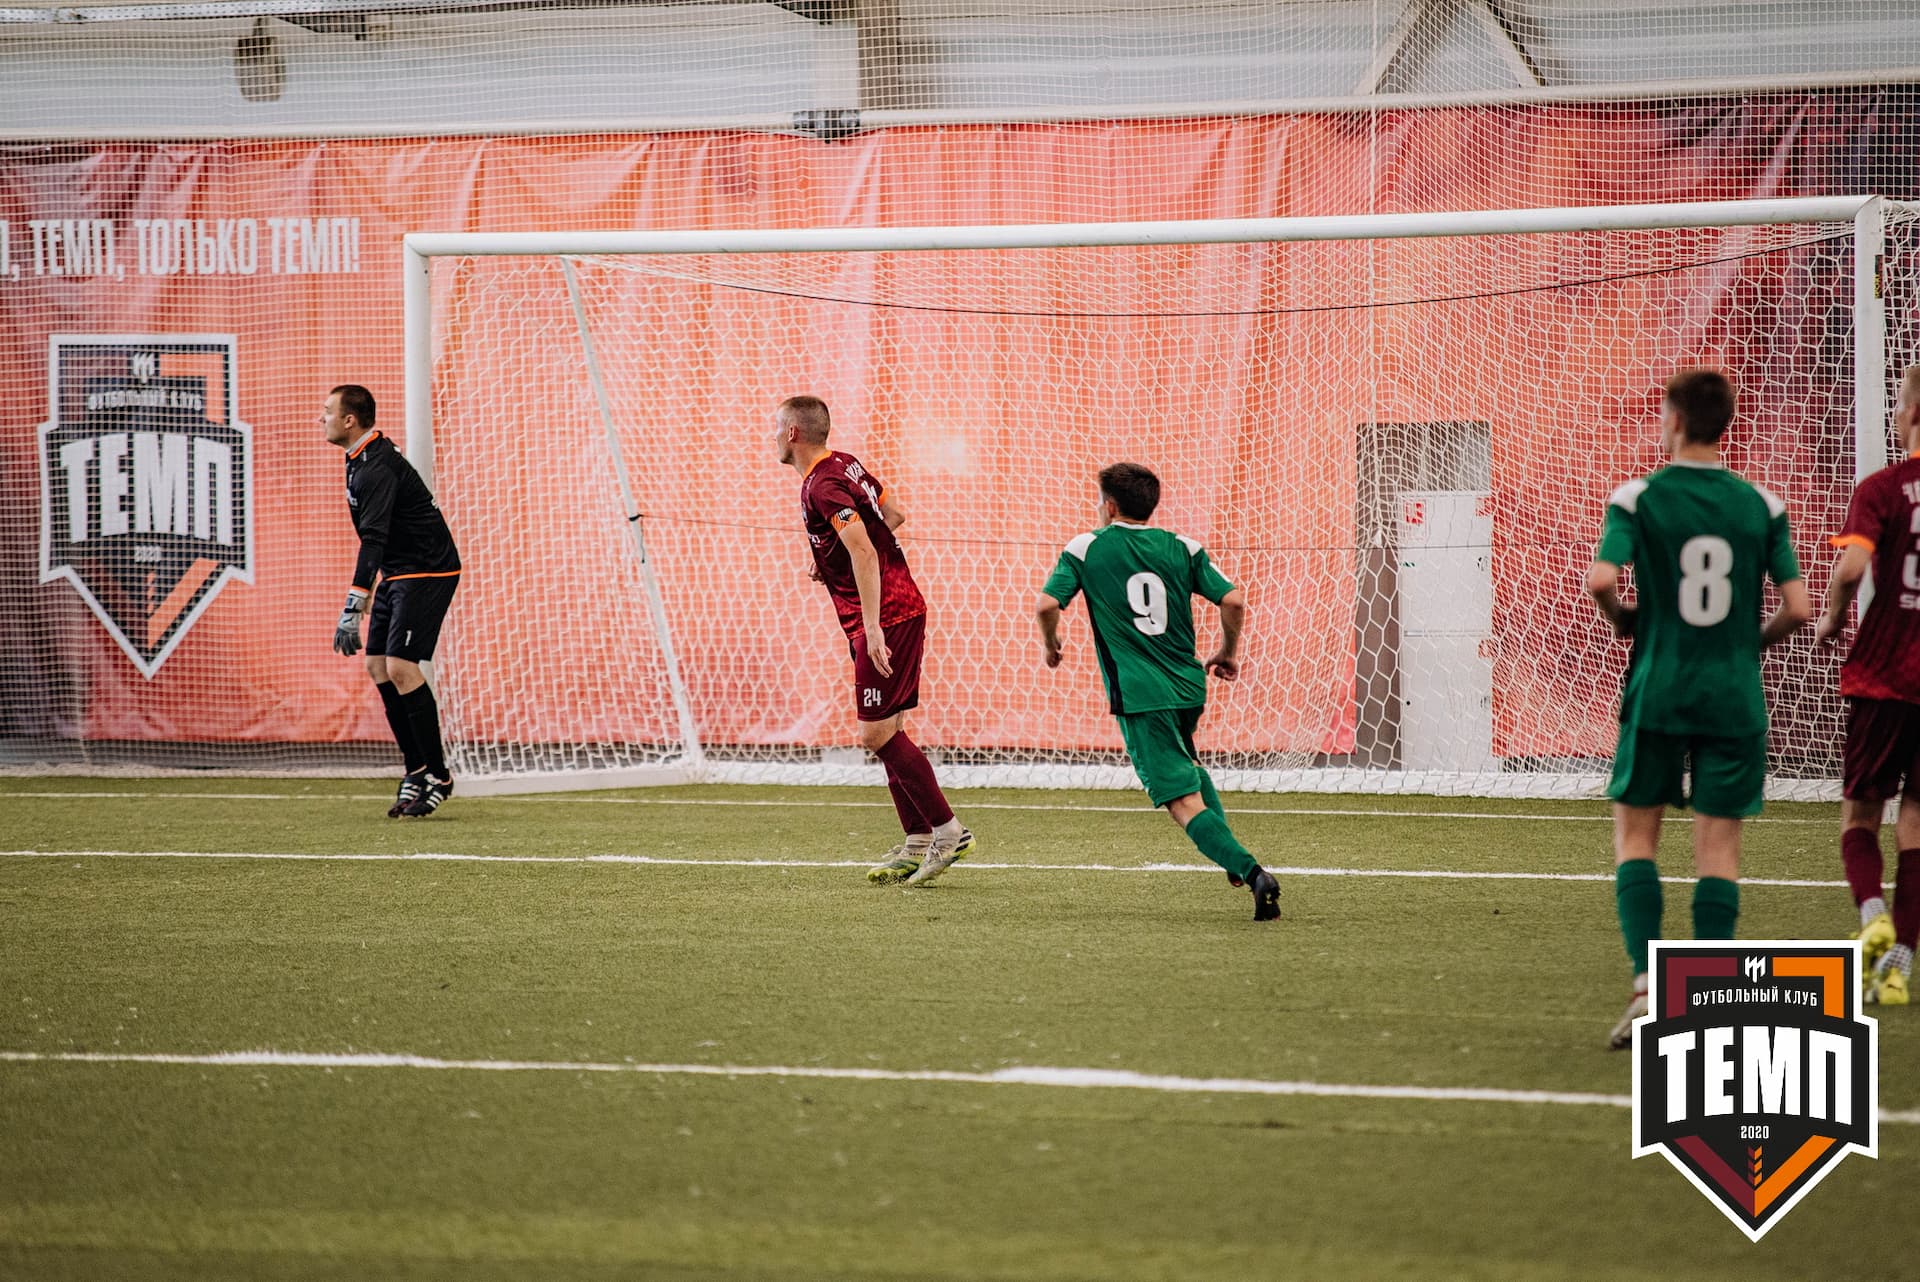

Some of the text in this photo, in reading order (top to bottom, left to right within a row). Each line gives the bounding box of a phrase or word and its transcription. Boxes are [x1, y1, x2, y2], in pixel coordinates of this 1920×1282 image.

[29, 218, 124, 282] ТЕМП,
[135, 217, 258, 275] ТОЛЬКО
[267, 217, 360, 274] ТЕМП!
[60, 433, 232, 547] ТЕМП
[1126, 571, 1168, 636] 9
[1678, 534, 1734, 627] 8
[405, 630, 412, 646] 1
[863, 687, 882, 707] 24
